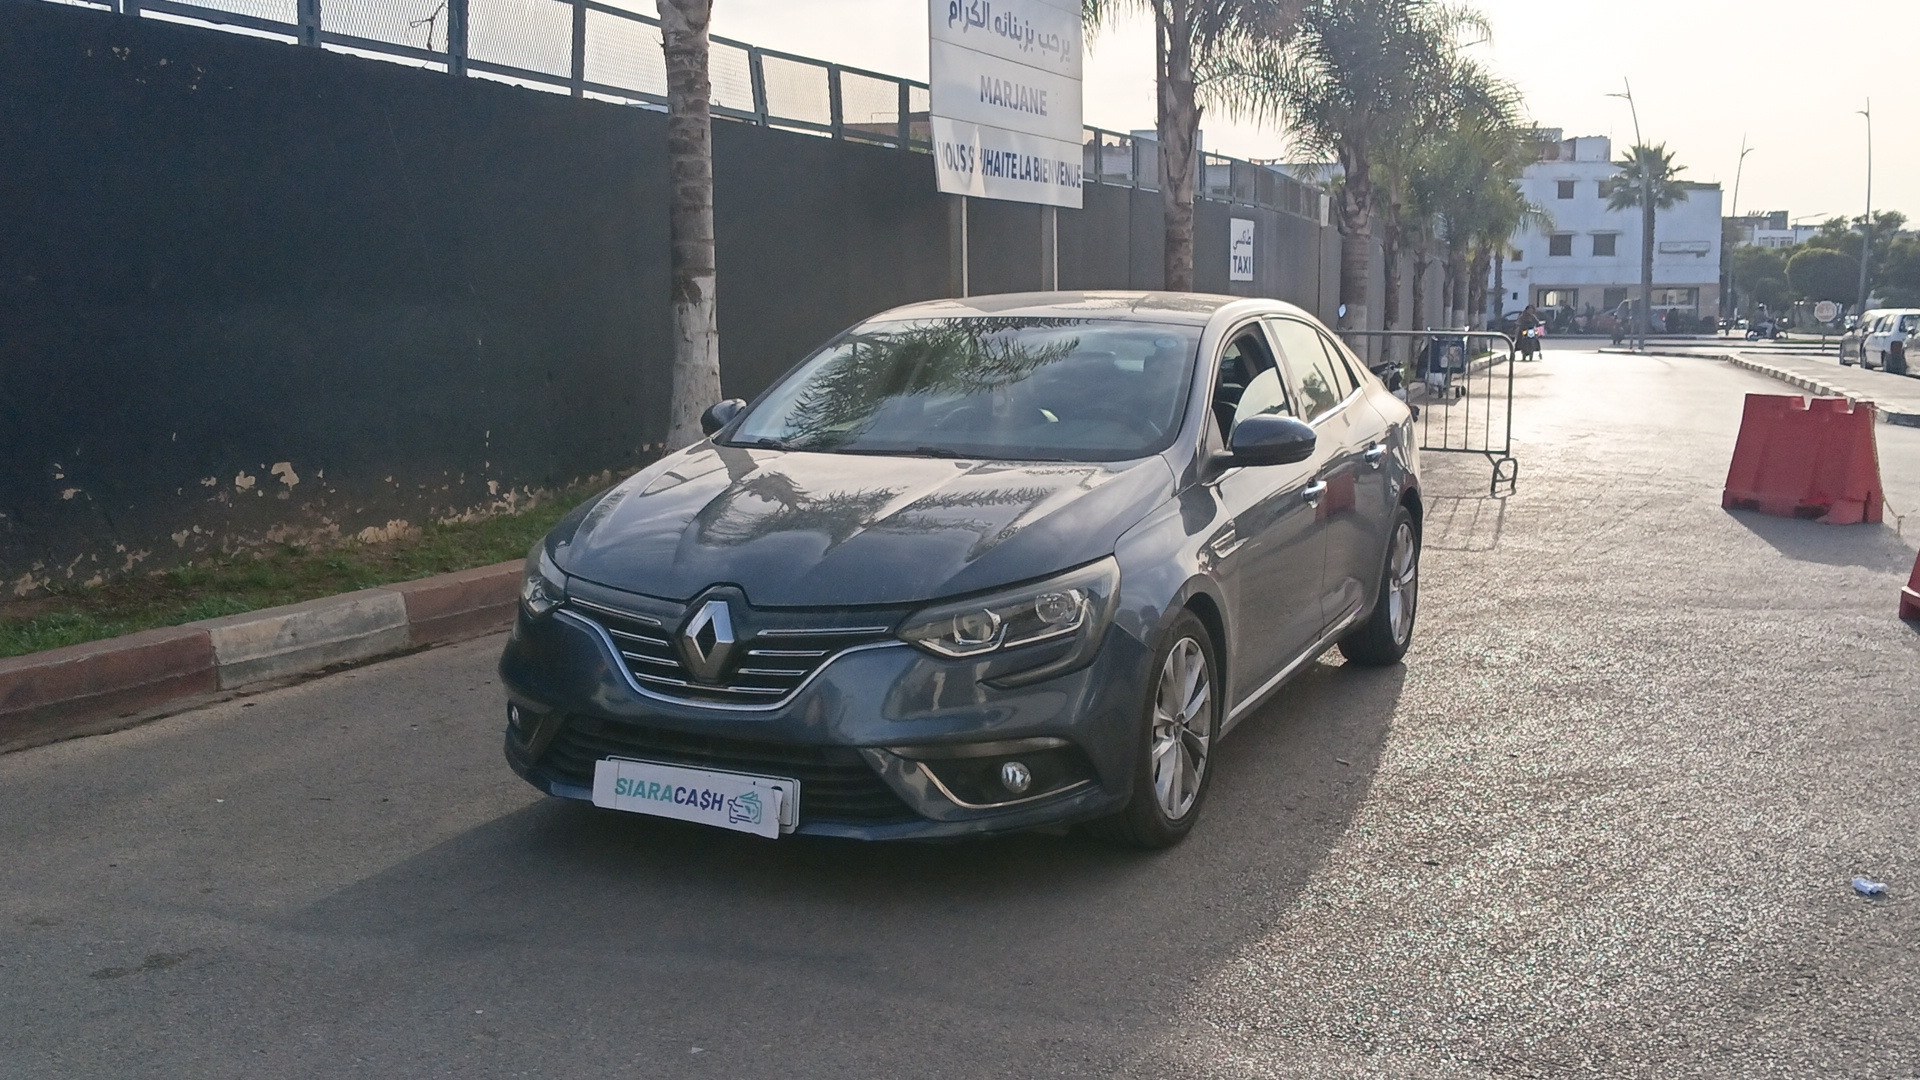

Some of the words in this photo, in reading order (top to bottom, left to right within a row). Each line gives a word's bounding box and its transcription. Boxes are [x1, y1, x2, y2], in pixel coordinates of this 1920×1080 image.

[948, 0, 991, 33] الكرام
[994, 12, 1034, 52] بزبنائه
[1038, 32, 1071, 63] يرحب
[980, 75, 1047, 116] MARJANE
[1019, 154, 1032, 181] LA
[1033, 157, 1081, 188] BIENVENUE
[1233, 255, 1251, 274] TAXI
[614, 777, 724, 812] SIARACA$H
